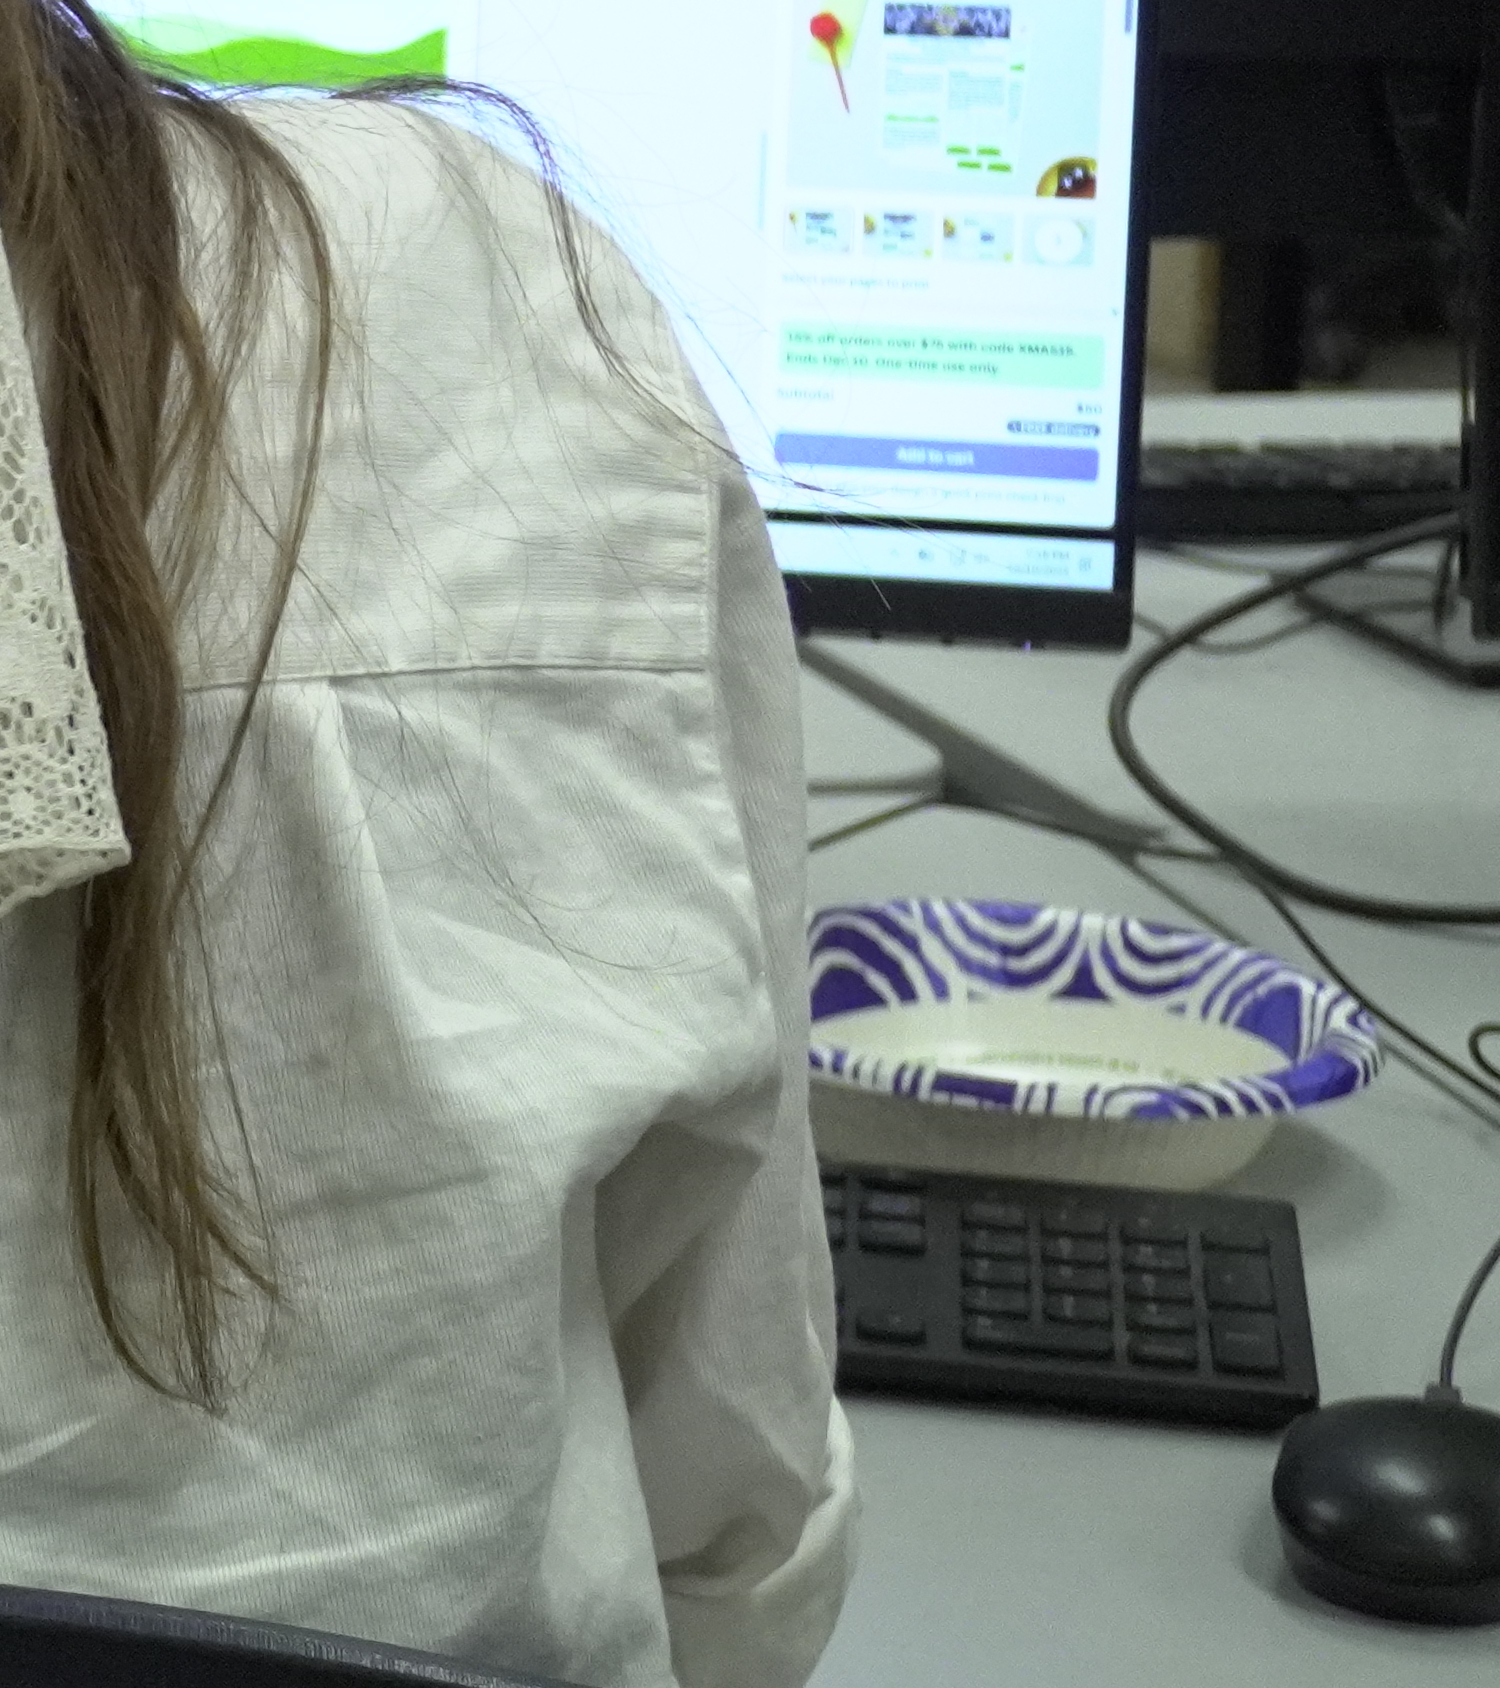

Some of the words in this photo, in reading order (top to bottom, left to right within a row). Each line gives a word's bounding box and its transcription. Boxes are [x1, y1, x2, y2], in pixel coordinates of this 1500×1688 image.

[817, 332, 836, 344] off
[838, 333, 883, 347] orders
[886, 336, 915, 349] over
[947, 338, 977, 352] with
[980, 340, 1015, 354] code
[786, 351, 818, 365] Ends
[942, 362, 965, 373] use
[777, 387, 833, 402] Subtotal
[894, 447, 926, 464] Add
[927, 448, 943, 465] to
[943, 449, 975, 467] cart
